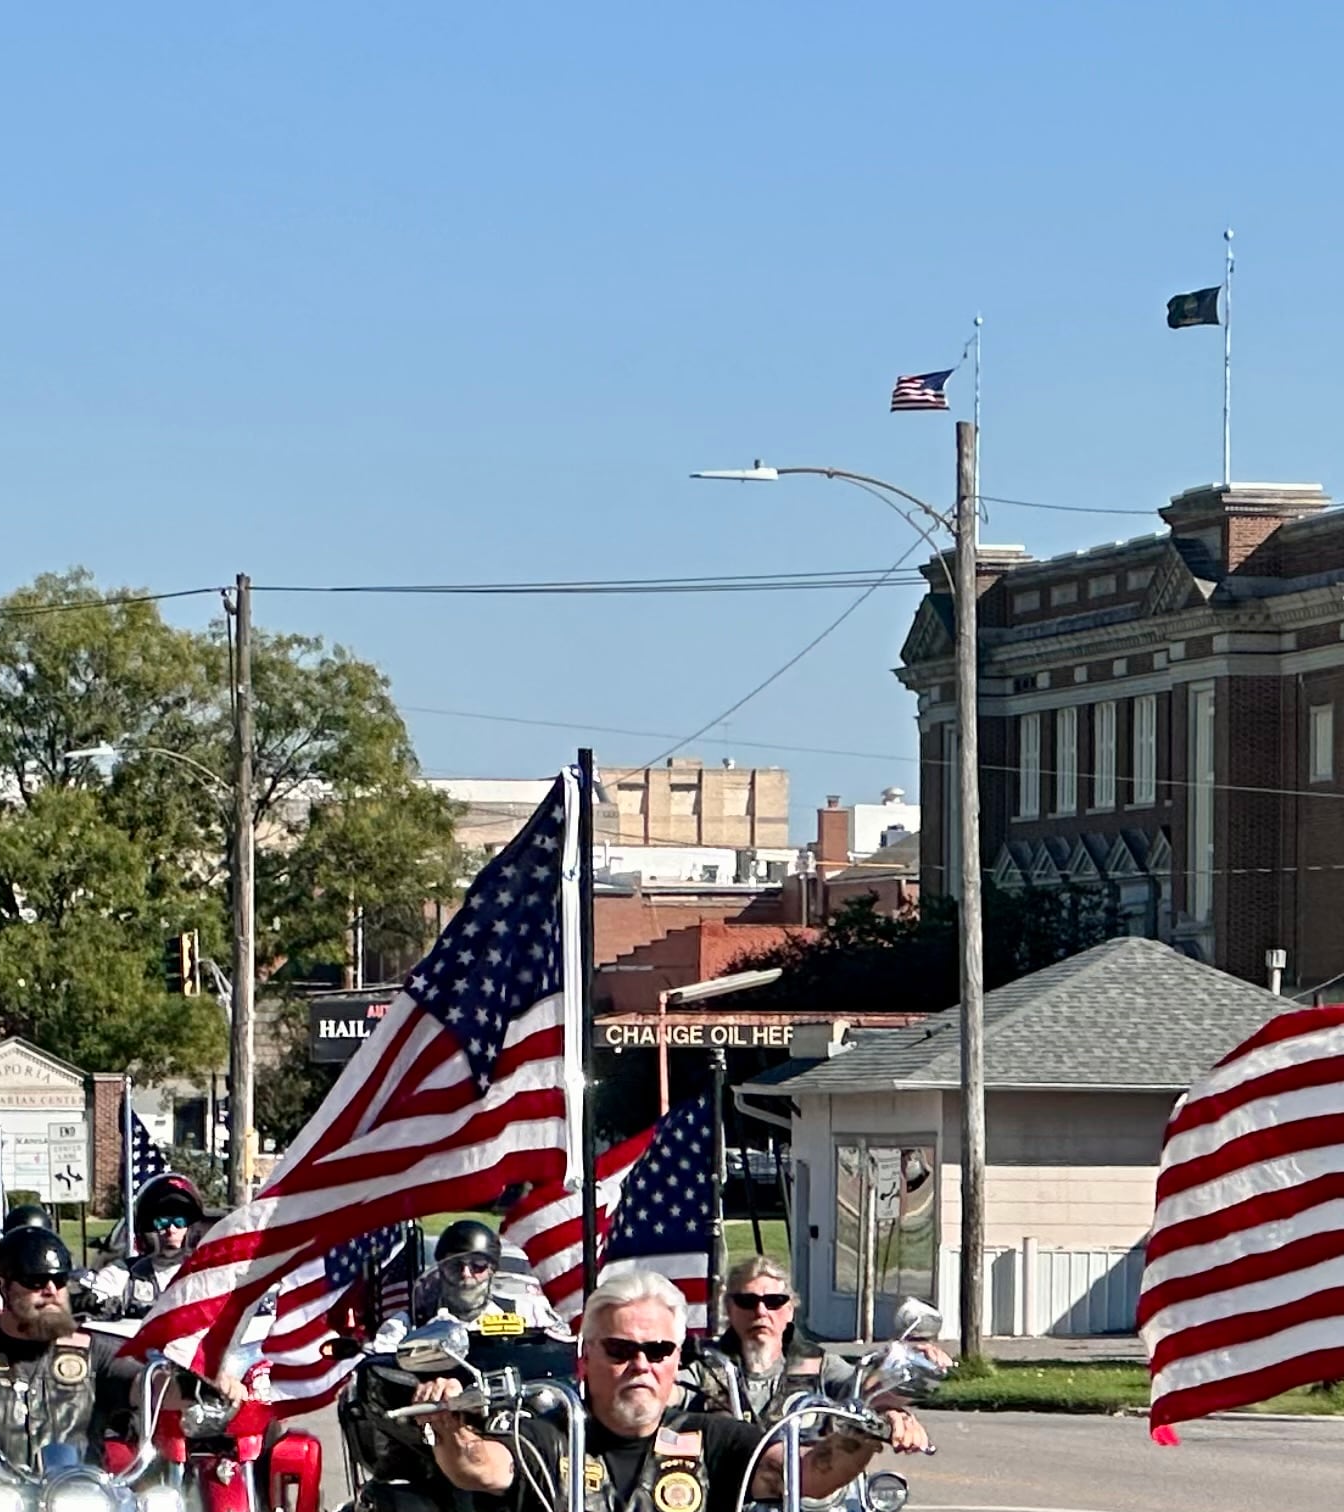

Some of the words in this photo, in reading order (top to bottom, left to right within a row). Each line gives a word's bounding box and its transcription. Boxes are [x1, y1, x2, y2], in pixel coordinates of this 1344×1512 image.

[367, 1004, 391, 1018] AUT
[319, 1019, 370, 1038] HAIL
[606, 1025, 704, 1044] CHANGE
[711, 1026, 747, 1045] OIL
[752, 1026, 793, 1045] HER
